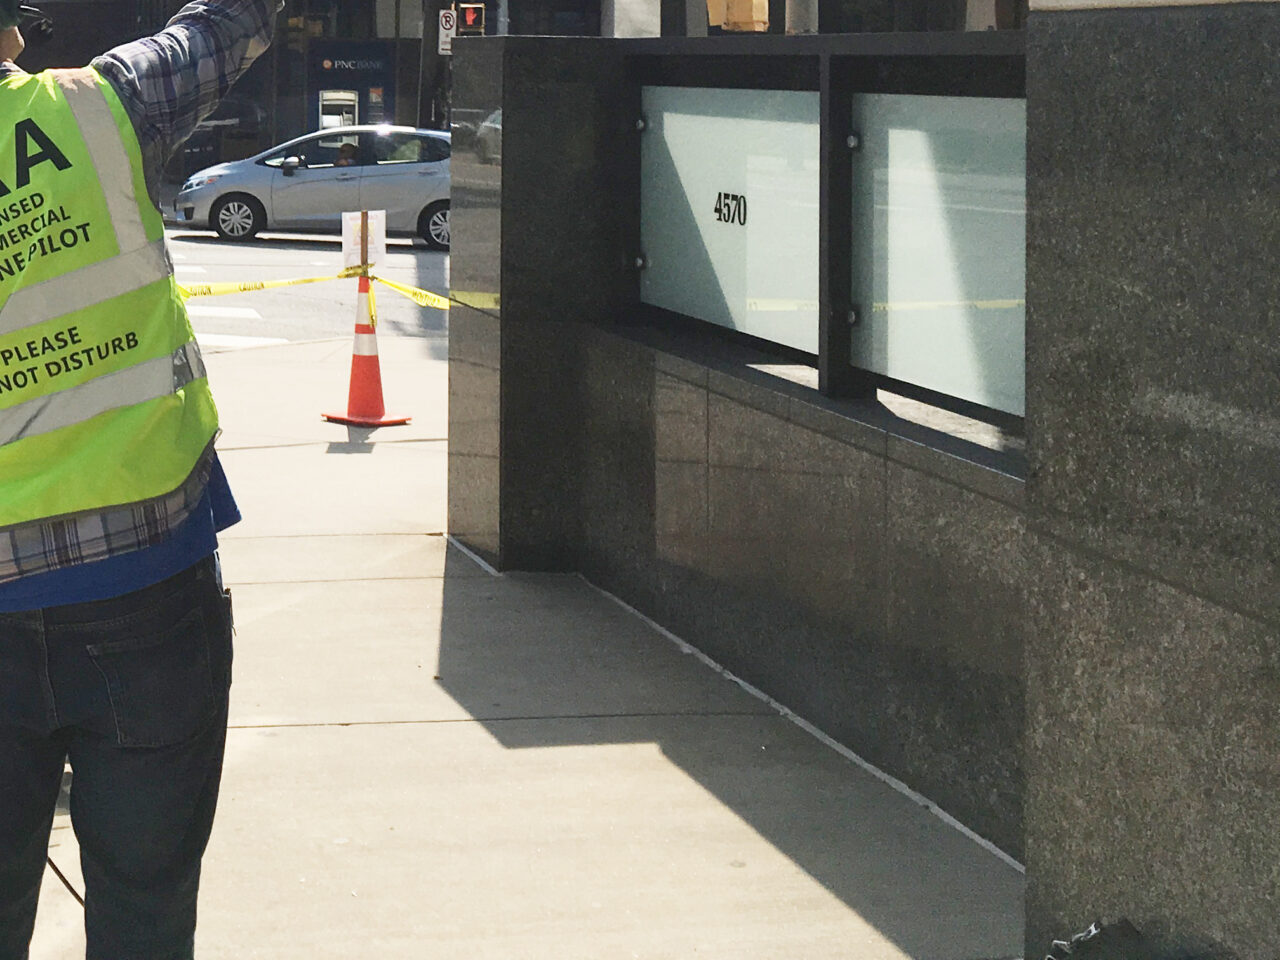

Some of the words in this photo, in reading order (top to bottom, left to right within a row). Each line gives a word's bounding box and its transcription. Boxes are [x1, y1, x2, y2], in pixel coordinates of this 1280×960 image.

[714, 191, 747, 226] 4570
[27, 222, 90, 262] PILOT
[0, 326, 82, 366] PLEASE
[44, 331, 139, 378] DISTURB
